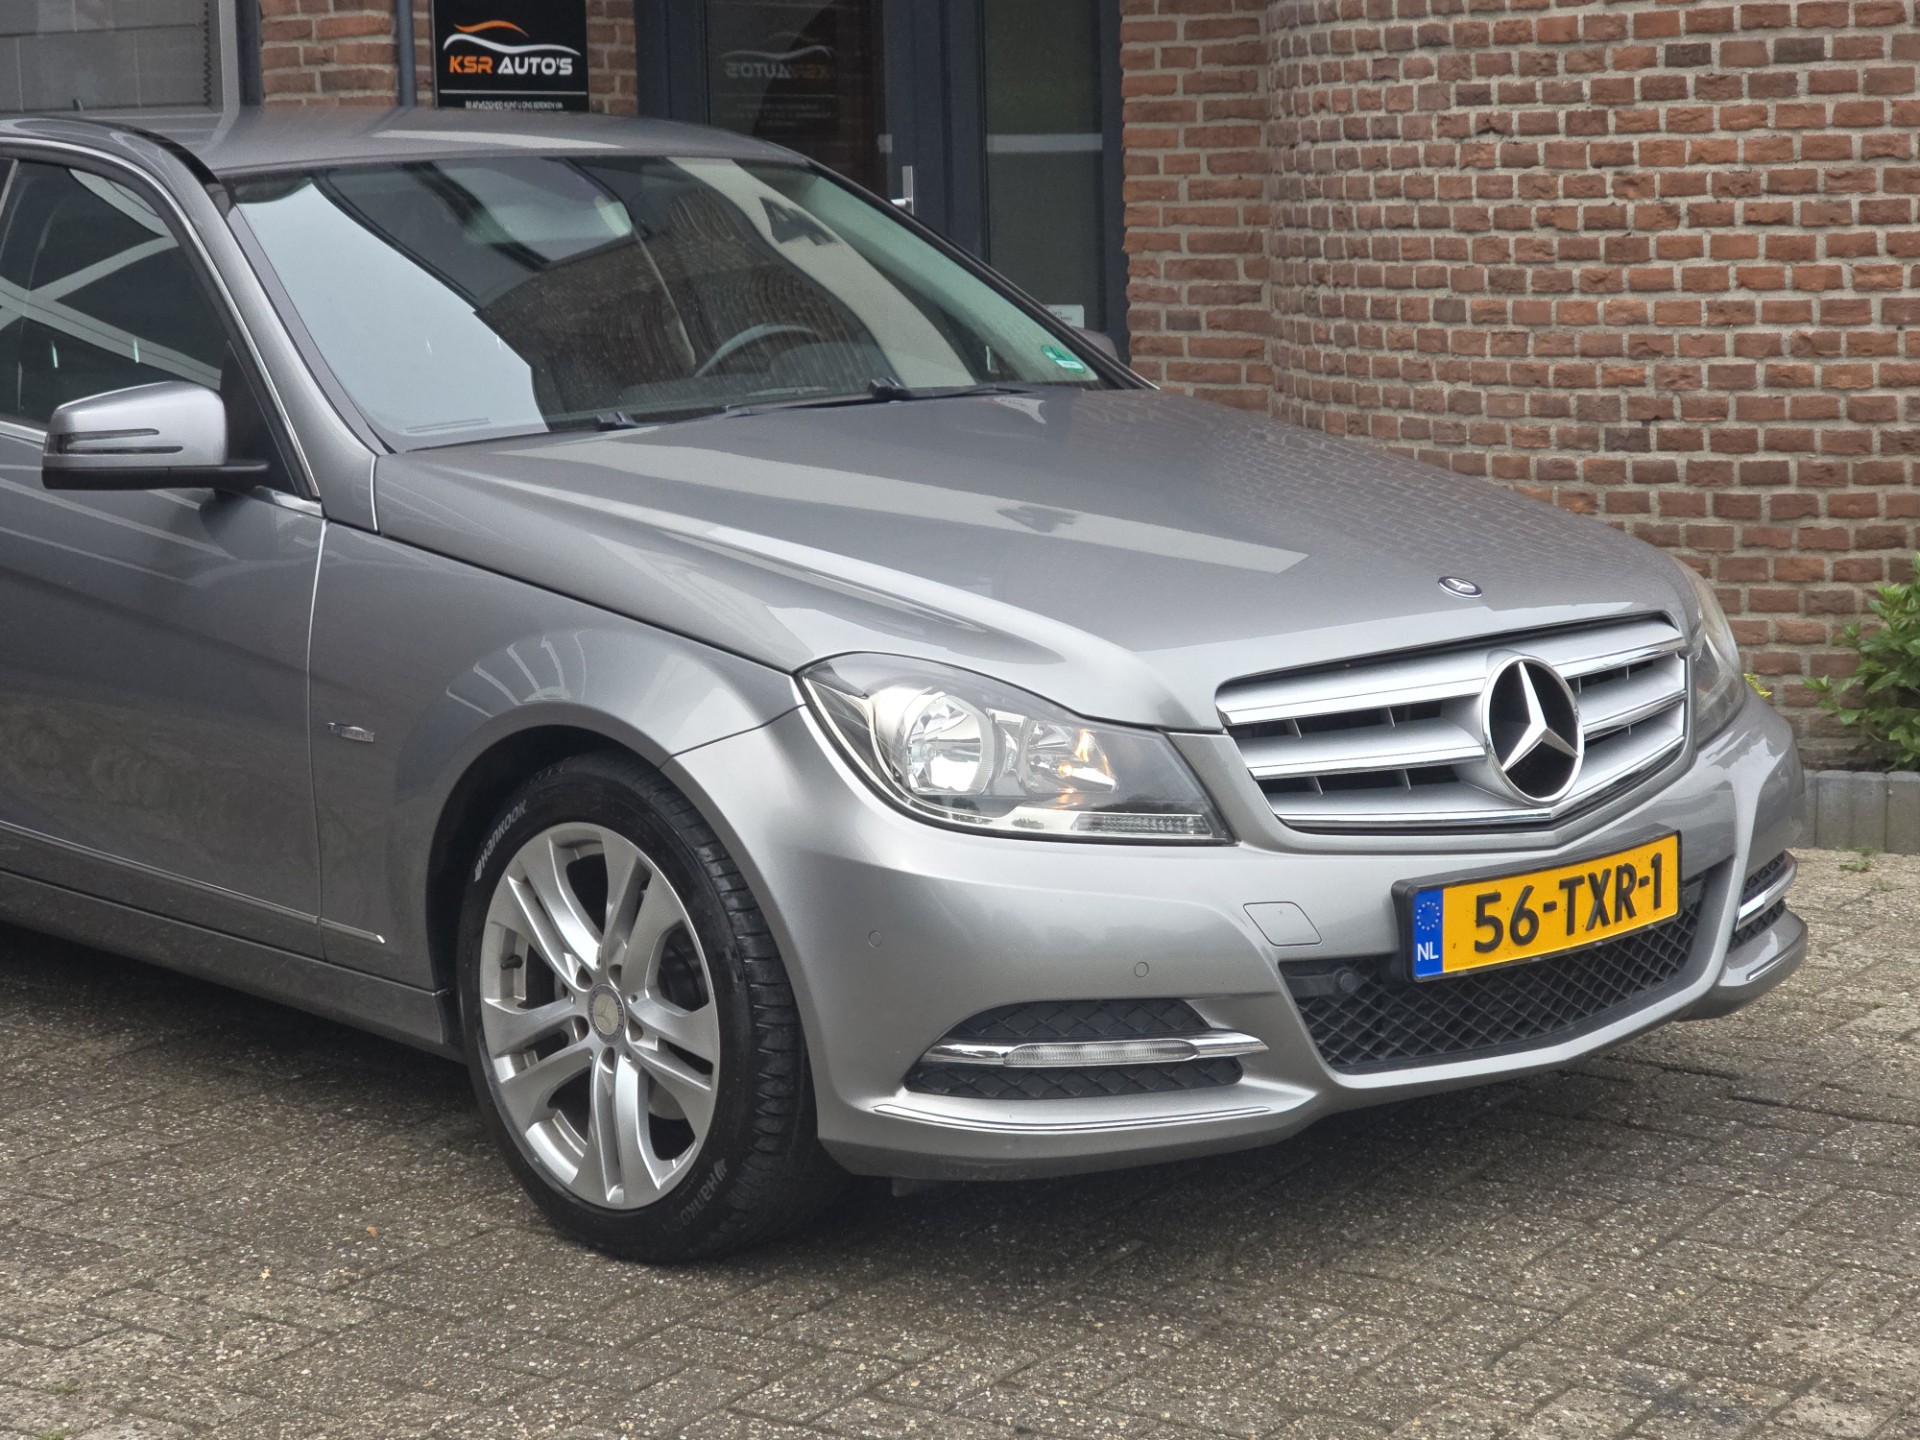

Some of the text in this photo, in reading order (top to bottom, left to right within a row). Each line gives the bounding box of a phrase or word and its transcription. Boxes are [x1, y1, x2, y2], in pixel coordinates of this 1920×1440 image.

[449, 55, 573, 76] KSR AUTO'S
[1474, 852, 1663, 955] 56-TXR-1
[1416, 941, 1439, 962] NL
